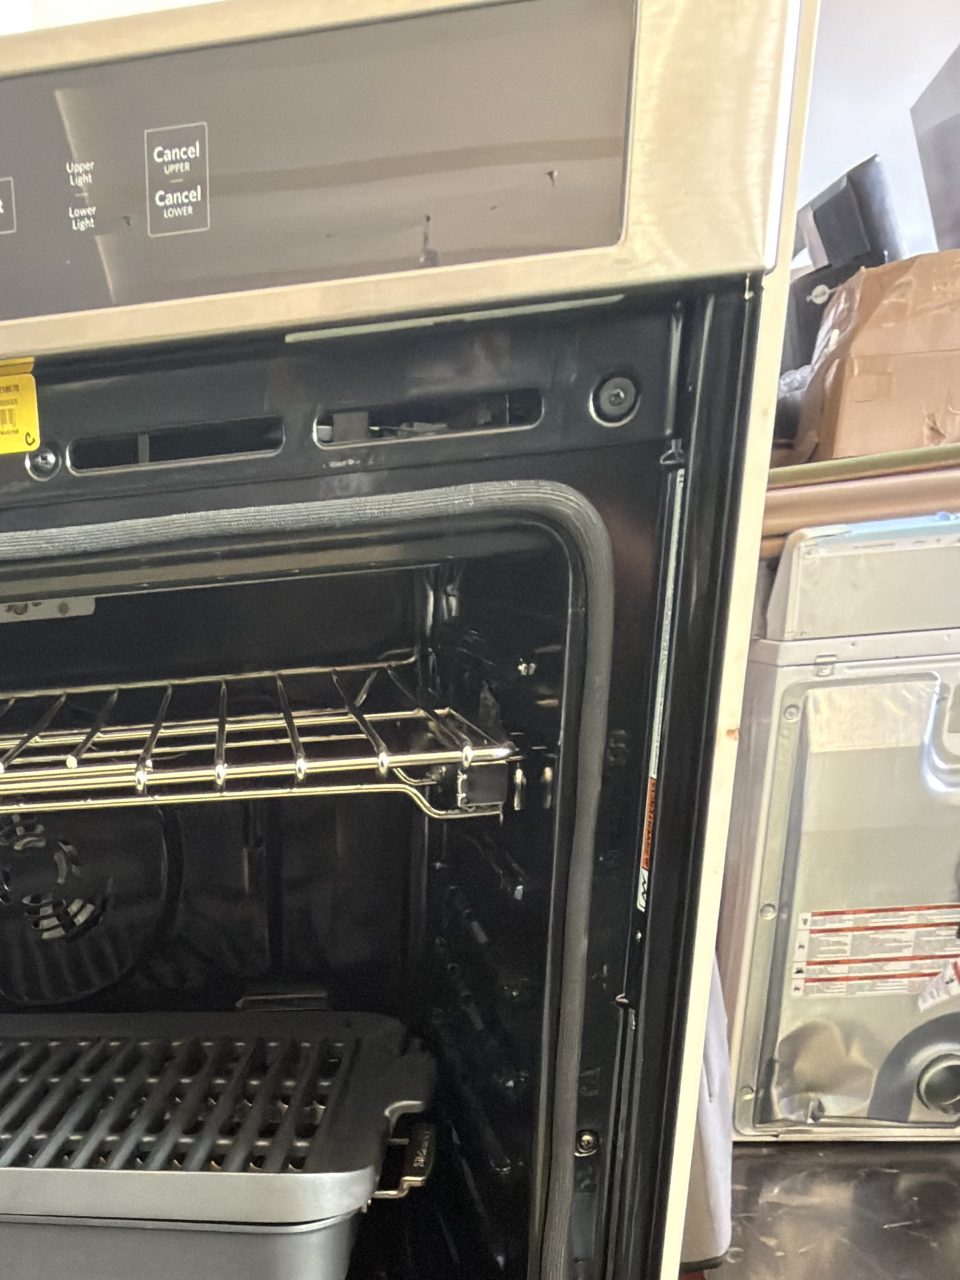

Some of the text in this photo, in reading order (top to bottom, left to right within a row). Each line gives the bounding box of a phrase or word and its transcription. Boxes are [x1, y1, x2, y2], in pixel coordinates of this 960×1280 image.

[153, 140, 200, 163] Cancel
[65, 161, 95, 174] Upper
[163, 161, 191, 175] UPPER
[69, 173, 93, 187] Light
[155, 185, 202, 207] Cancel
[68, 205, 96, 218] Lower
[163, 205, 194, 219] LOWER
[71, 217, 96, 231] Light
